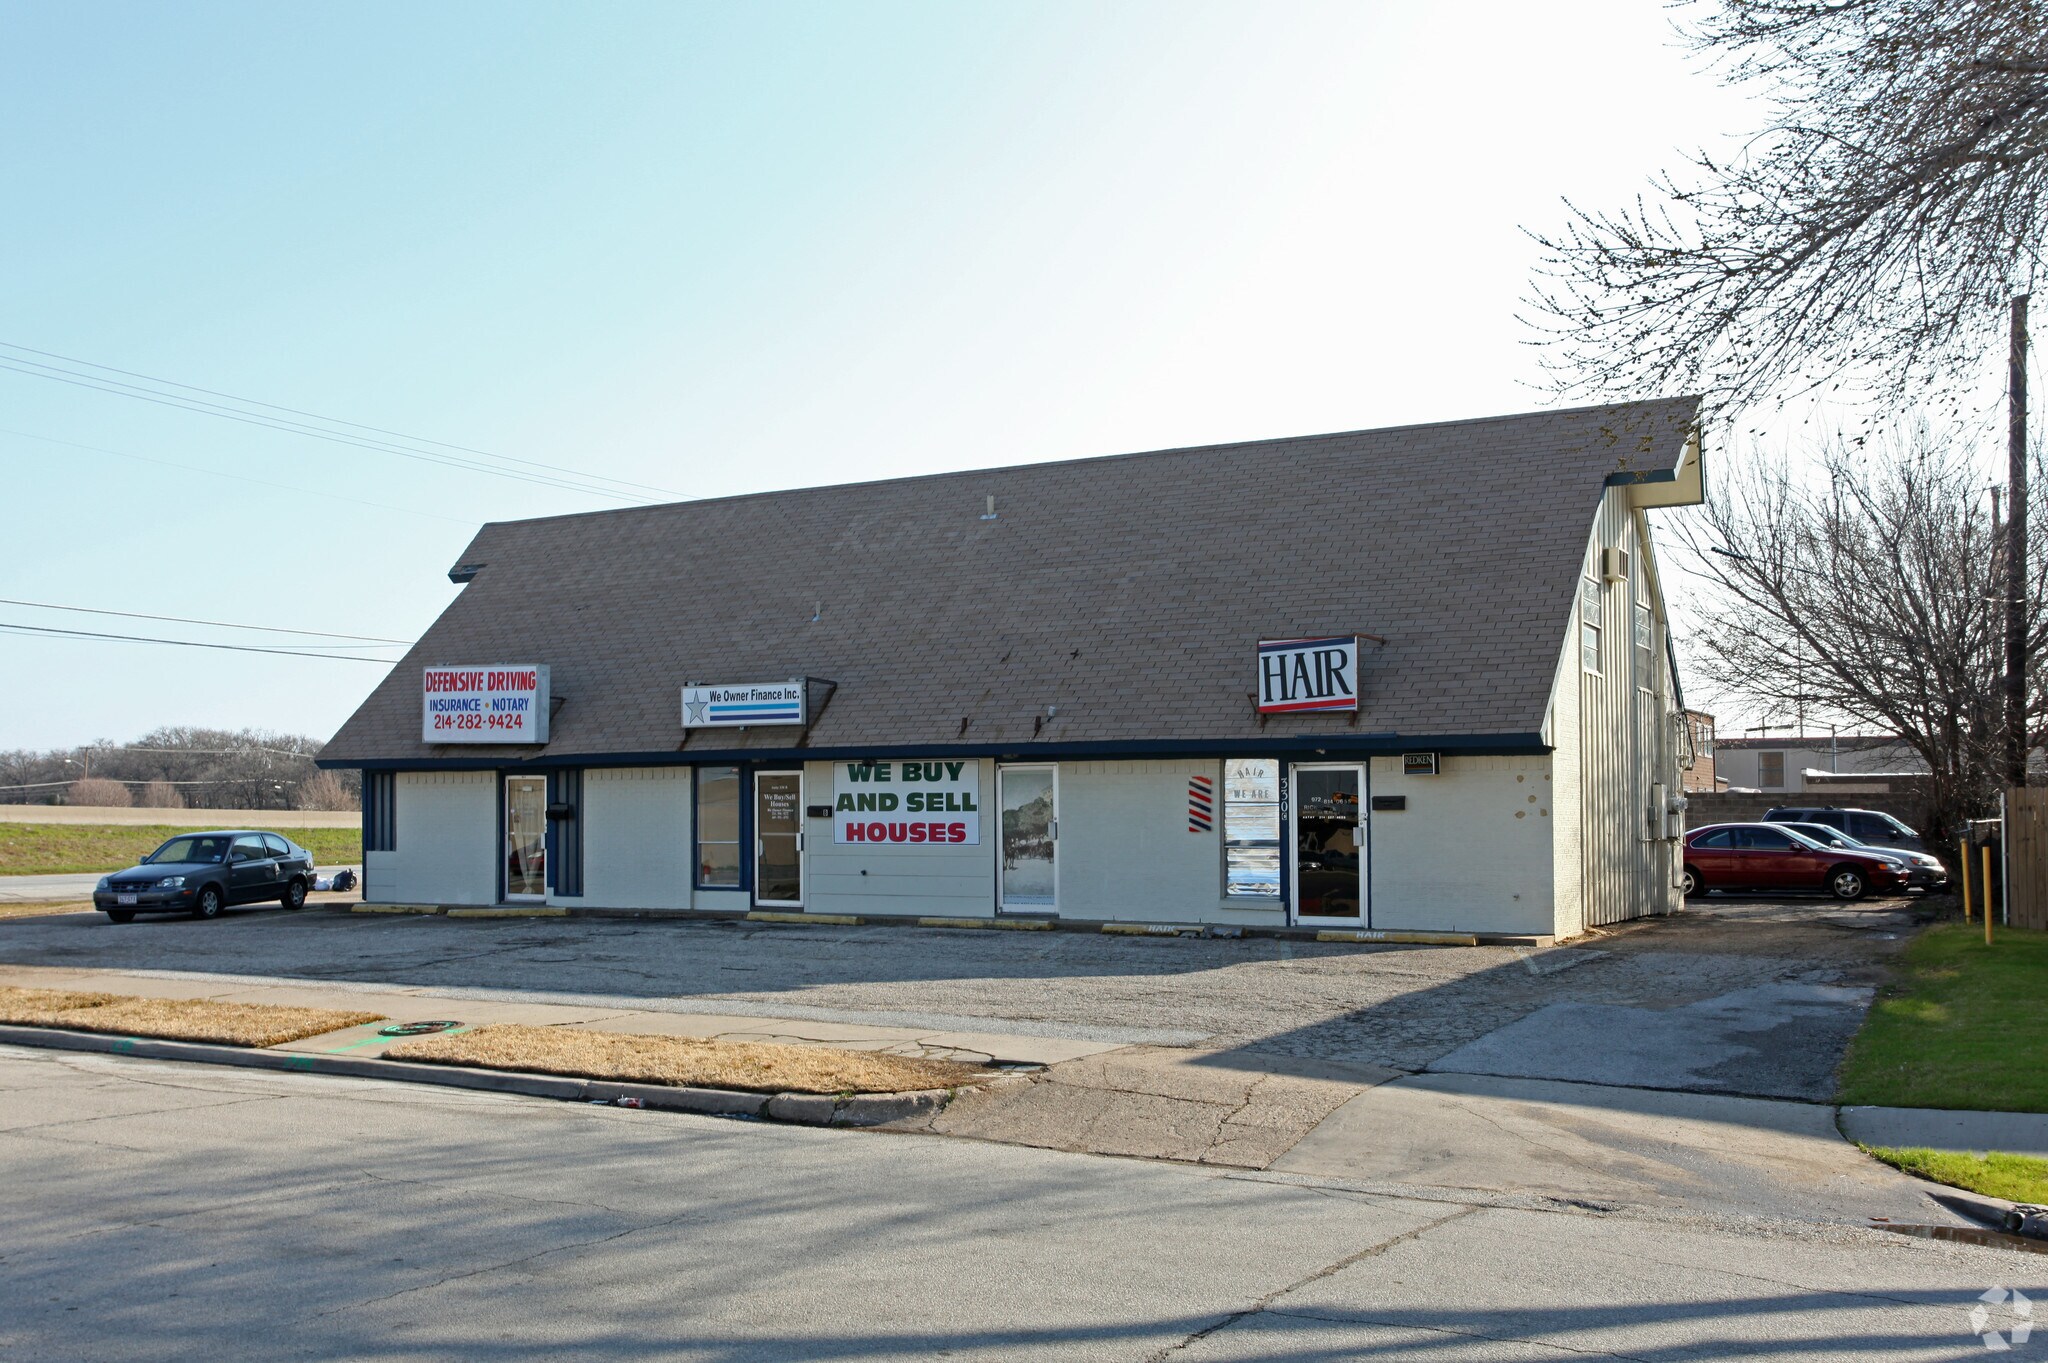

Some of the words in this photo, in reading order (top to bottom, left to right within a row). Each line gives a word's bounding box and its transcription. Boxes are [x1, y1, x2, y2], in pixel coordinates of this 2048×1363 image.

[425, 671, 484, 692] DEFENSIVE
[487, 671, 536, 691] DRIVING
[1261, 649, 1353, 702] HAIR
[709, 690, 721, 702] We
[723, 690, 749, 701] Owner
[751, 688, 782, 700] Finance
[784, 688, 800, 699] Inc.
[429, 698, 481, 711] INSURANCE
[492, 697, 529, 711] NOTARY
[434, 713, 523, 729] 214-282-9424
[1404, 755, 1433, 765] REDKEN
[847, 763, 891, 782] WE
[902, 762, 965, 782] BUY
[1237, 767, 1264, 779] HAIR
[835, 792, 899, 812] AND
[906, 792, 977, 812] SELL
[1233, 790, 1246, 798] WE
[1251, 790, 1269, 799] ARE
[846, 822, 966, 842] HOUSES
